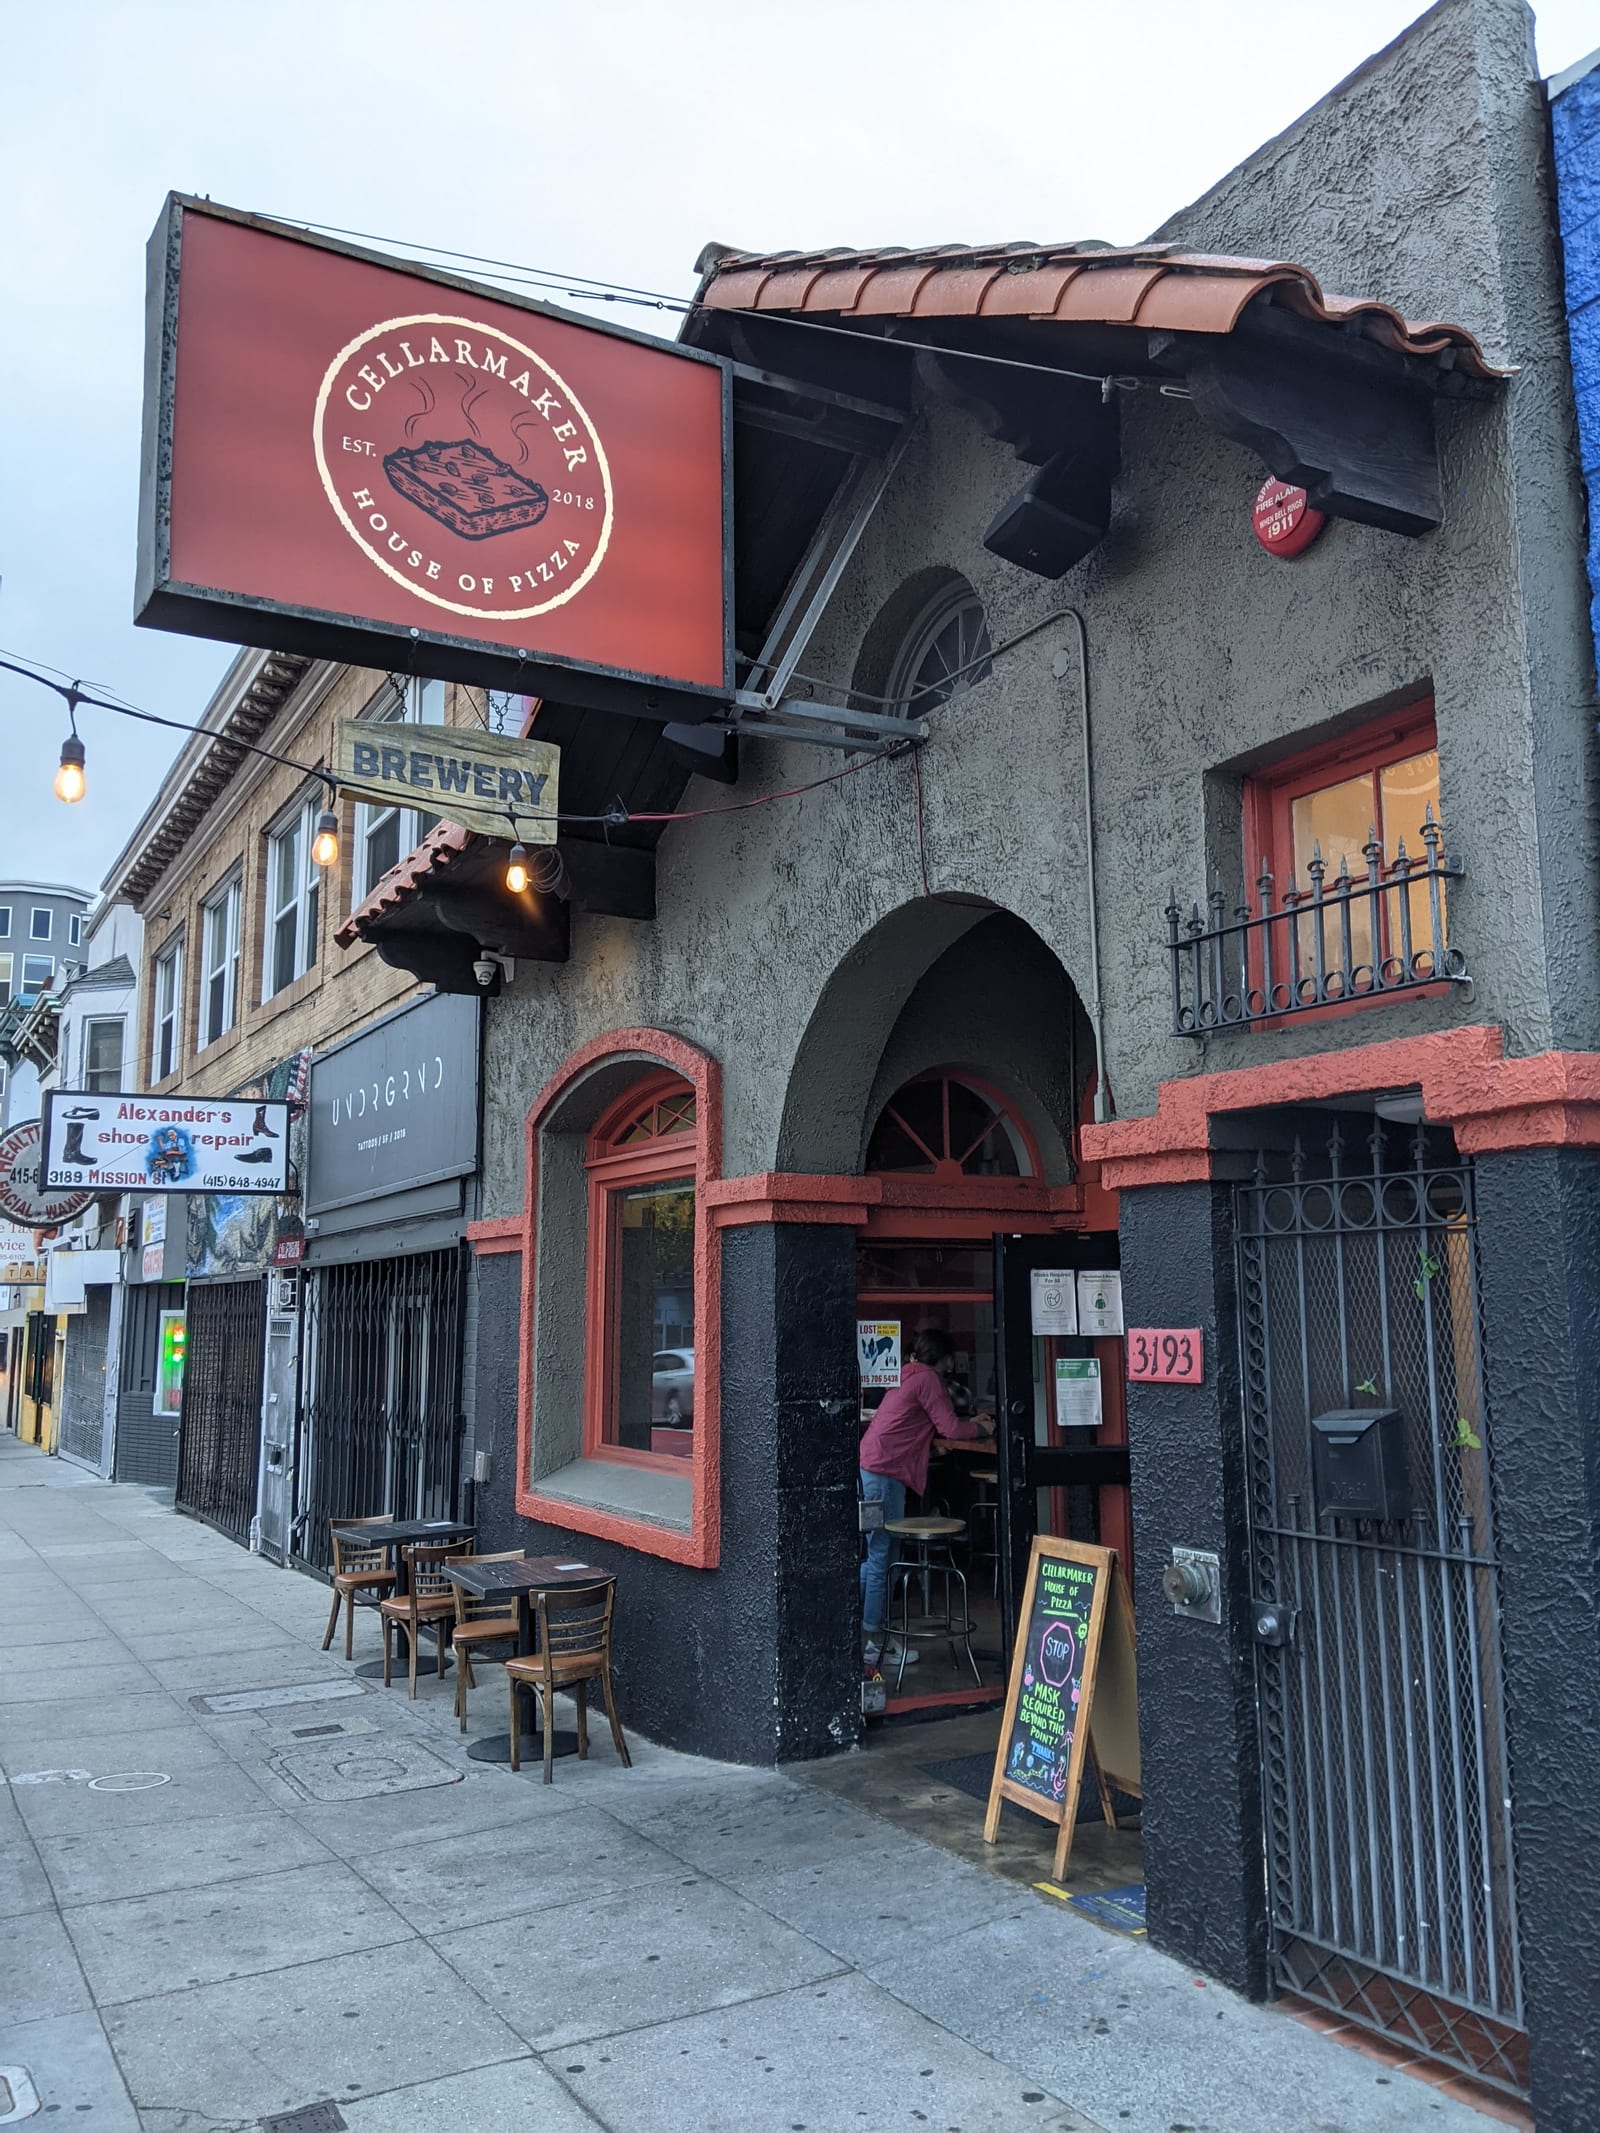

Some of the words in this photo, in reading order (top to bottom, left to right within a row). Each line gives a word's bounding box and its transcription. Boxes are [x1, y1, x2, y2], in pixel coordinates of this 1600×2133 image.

[346, 337, 588, 471] CELLARMAKER
[342, 436, 377, 457] EST.
[552, 489, 595, 510] 2018
[1256, 497, 1274, 514] FIRE
[1275, 485, 1301, 504] ALAR
[1259, 514, 1274, 529] WHEN
[1275, 508, 1288, 521] BELL
[1287, 499, 1303, 514] RINGS
[1272, 514, 1293, 535] 911
[352, 488, 442, 580] HOUSE
[458, 574, 494, 594] OF
[509, 537, 581, 593] PIZZA
[353, 741, 549, 806] BREWERY
[117, 1102, 232, 1124] Alexander's
[98, 1127, 150, 1144] shoe
[191, 1133, 254, 1150] repair
[358, 1136, 378, 1151] TATTOOS
[49, 1170, 83, 1183] 3189
[89, 1169, 147, 1185] MISSION
[46, 1192, 89, 1217] WAXIN
[860, 1325, 876, 1334] LOST
[1133, 1334, 1193, 1376] 3193
[1042, 1563, 1094, 1585] CELLARMAKER
[1044, 1580, 1065, 1594] HOUSE
[1069, 1586, 1079, 1597] OF
[1051, 1596, 1072, 1610] PIZZA
[1045, 1636, 1070, 1661] STOP
[1034, 1682, 1061, 1706] MASK
[1022, 1694, 1065, 1722] REQUIRED
[1020, 1708, 1047, 1730] BEYOND
[1048, 1720, 1065, 1736] THIS
[1031, 1741, 1055, 1762] THANKS
